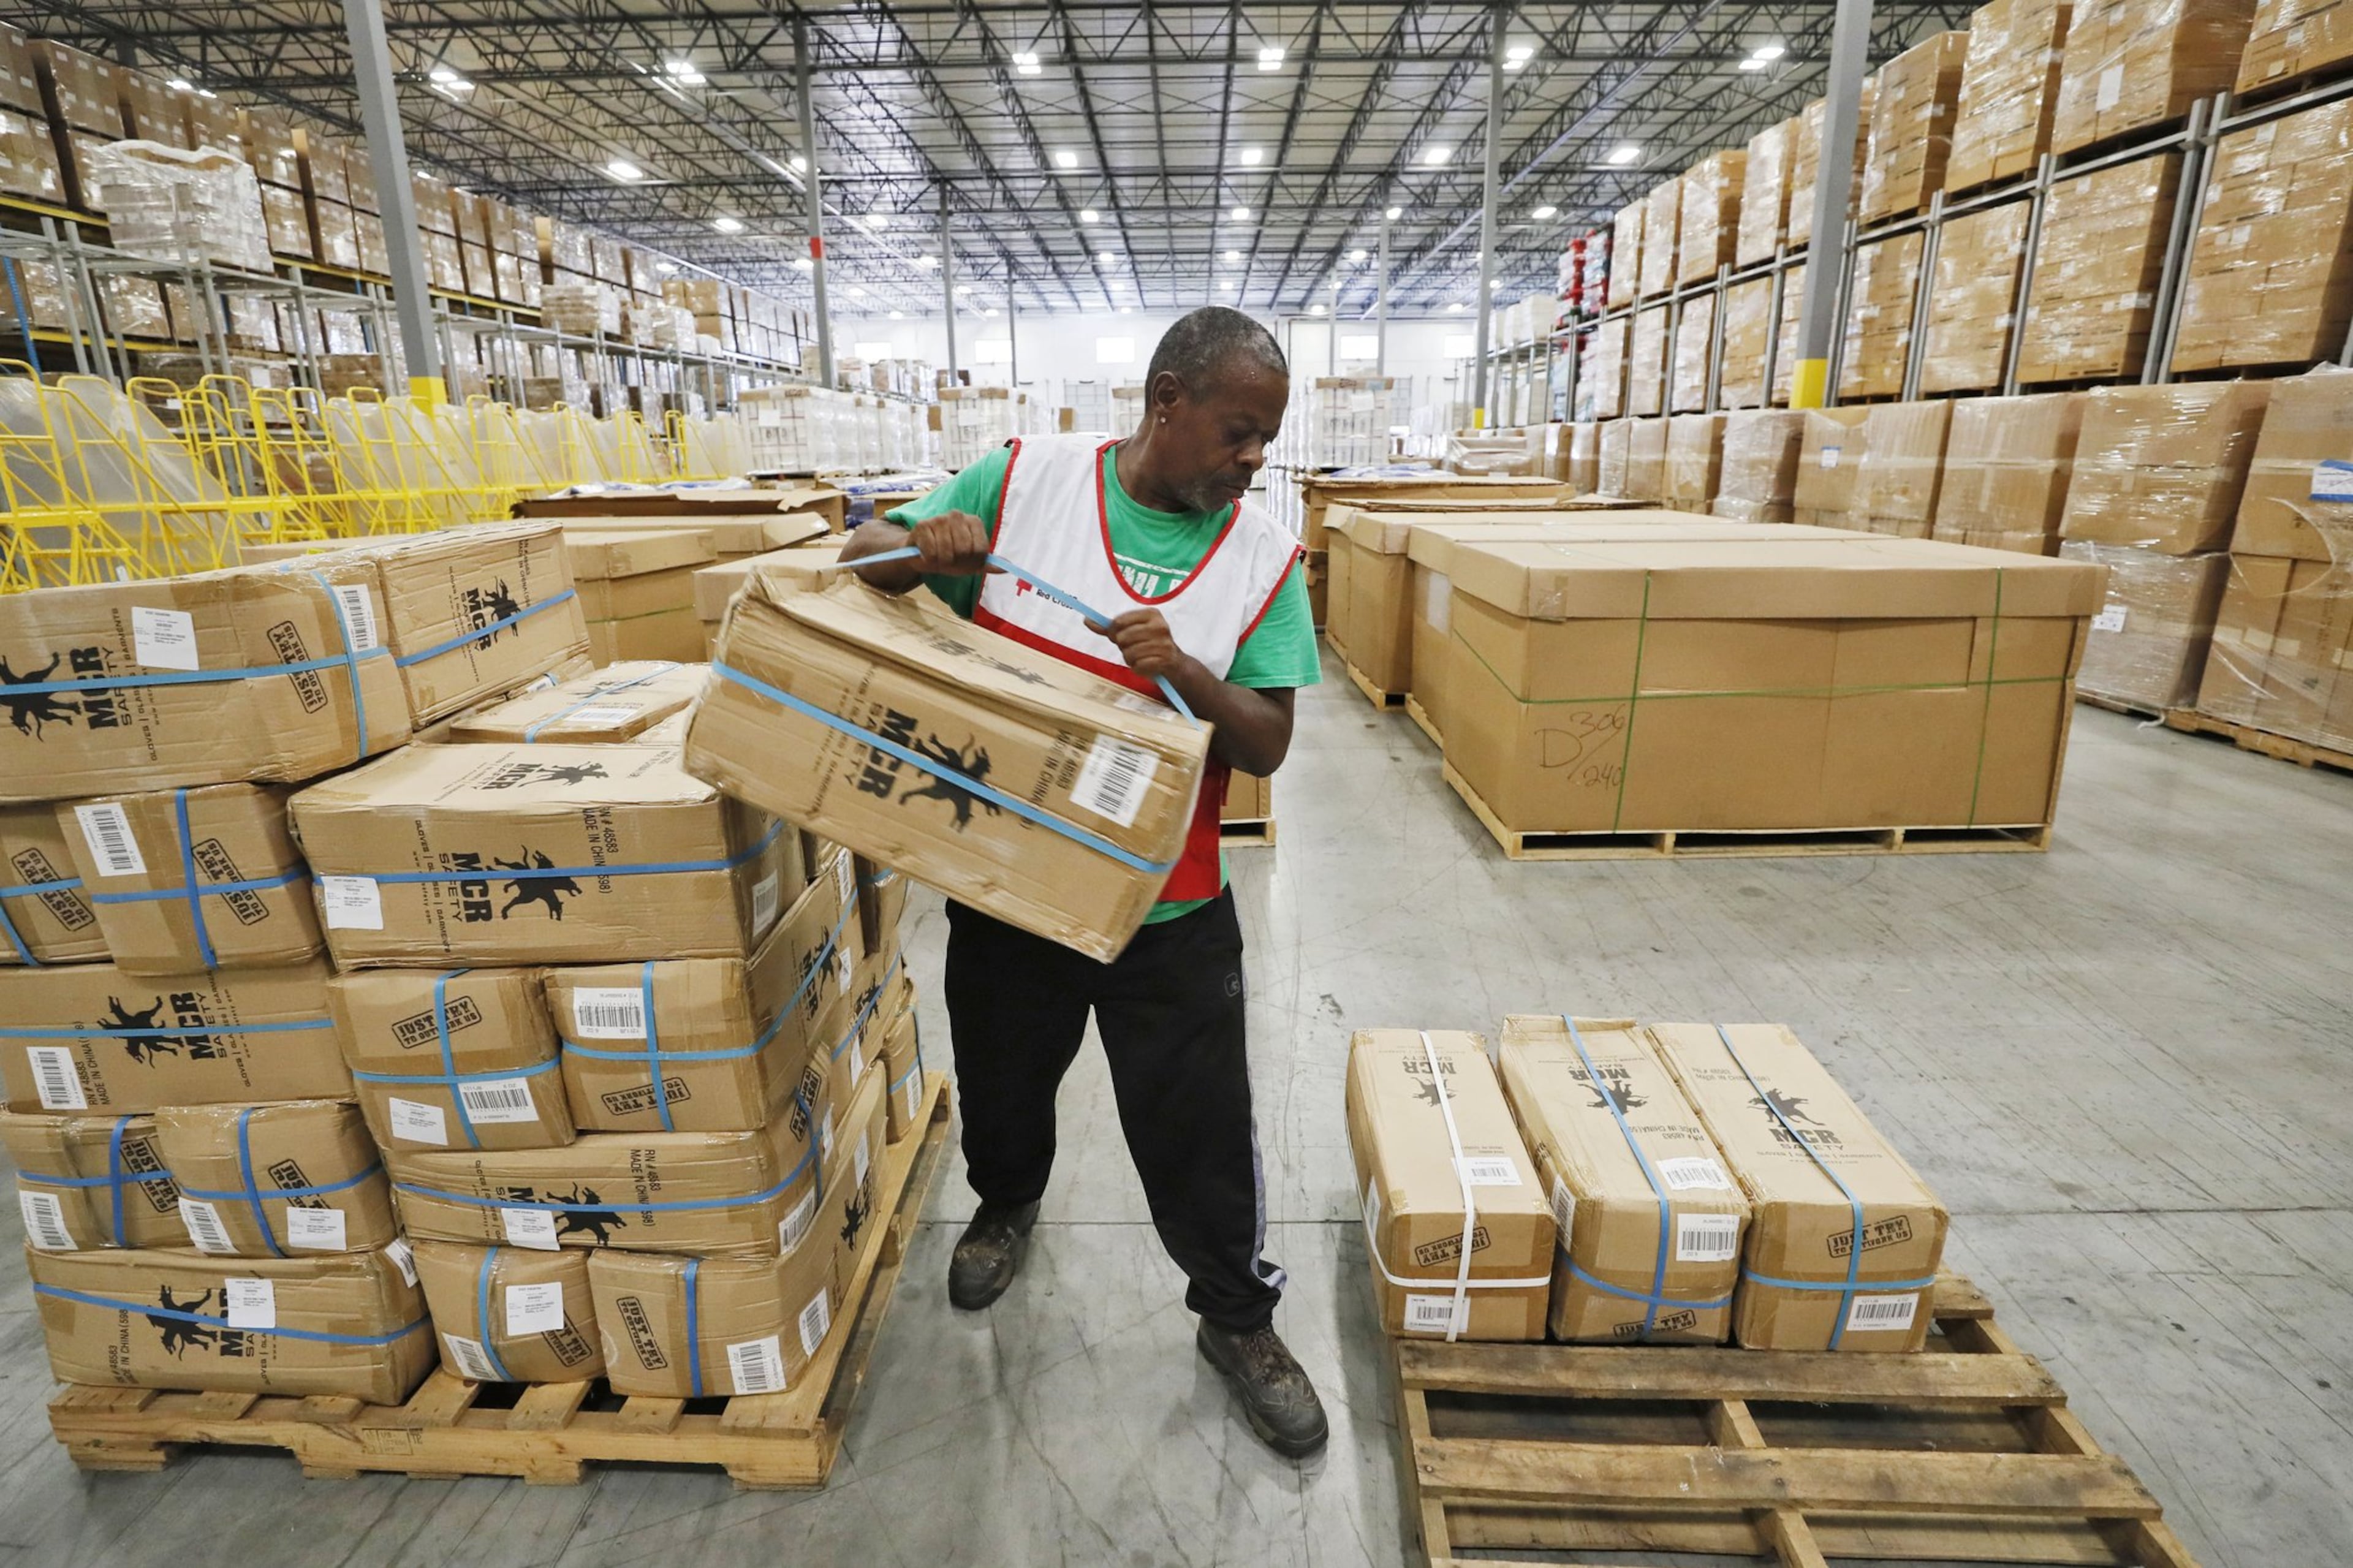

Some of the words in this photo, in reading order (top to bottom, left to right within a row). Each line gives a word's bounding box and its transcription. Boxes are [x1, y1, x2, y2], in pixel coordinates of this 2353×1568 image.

[464, 587, 493, 651] MCR
[283, 624, 295, 640] US
[272, 629, 298, 665] TRY
[290, 640, 318, 687] OUTORK
[70, 646, 119, 730] MCR
[313, 688, 325, 703] TO
[858, 704, 917, 801] MCR
[1534, 727, 1583, 768] D
[482, 764, 543, 790] MCR
[415, 819, 429, 852] GLOVES
[588, 833, 600, 843] IN
[602, 827, 618, 854] 48583
[28, 851, 43, 866] US
[207, 842, 221, 856] US
[196, 847, 226, 881] TRY
[451, 852, 492, 923] MCR
[42, 887, 81, 930] JUST
[75, 907, 89, 922] TO
[225, 887, 256, 922] JUS
[250, 901, 263, 916] TO
[169, 990, 216, 1060] MCR
[196, 991, 227, 1058] SAETY
[396, 1013, 437, 1037] JUST
[403, 1034, 417, 1045] TO
[463, 1011, 477, 1022] US
[75, 1061, 90, 1085] 48583
[91, 1070, 101, 1079] IN
[1401, 1061, 1457, 1074] MCR
[95, 1082, 110, 1105] MADE
[643, 1087, 686, 1105] JUT
[665, 1080, 680, 1089] TO
[87, 1094, 98, 1105] RN
[609, 1098, 644, 1113] TRY
[1659, 1131, 1686, 1140] 48583
[1678, 1124, 1700, 1134] MADE
[1768, 1129, 1844, 1144] MCR
[129, 1140, 162, 1175] JUST
[630, 1149, 642, 1173] MADE
[643, 1149, 656, 1162] RN
[121, 1145, 135, 1157] TO
[154, 1196, 170, 1210] US
[1873, 1218, 1905, 1237] TRY
[1417, 1246, 1430, 1255] US
[1833, 1246, 1847, 1256] TO
[1895, 1230, 1908, 1240] US
[1421, 1246, 1450, 1265] TRY
[1661, 1310, 1692, 1328] TRY
[619, 1301, 629, 1312] TO
[624, 1314, 648, 1355] OUTWORK
[643, 1355, 653, 1367] US
[625, 1299, 650, 1335] JUST
[642, 1337, 664, 1366] TRY
[120, 1356, 130, 1365] IN
